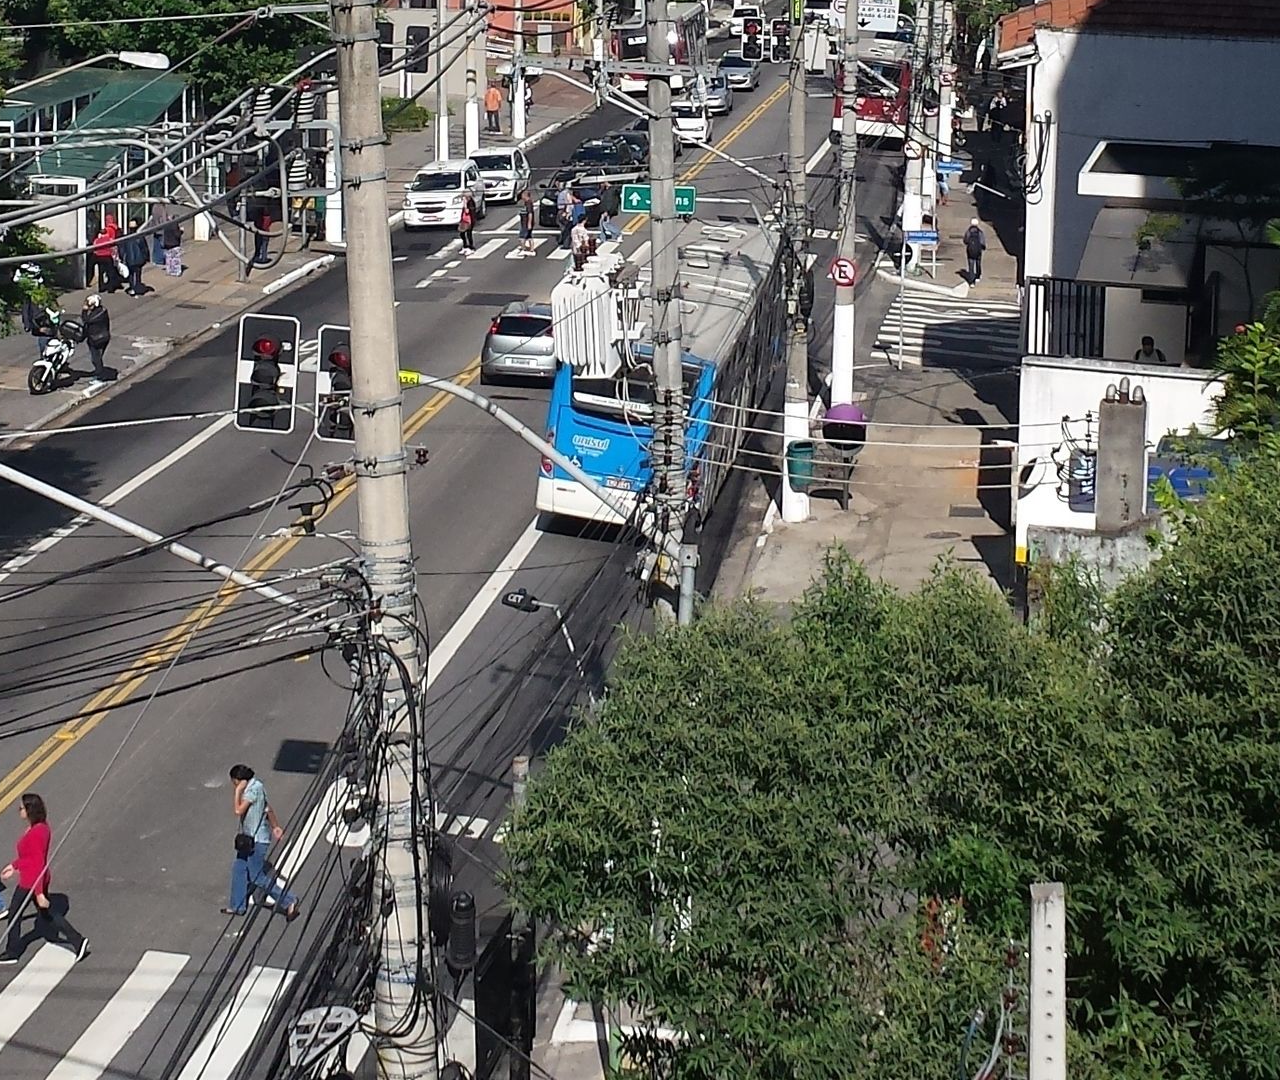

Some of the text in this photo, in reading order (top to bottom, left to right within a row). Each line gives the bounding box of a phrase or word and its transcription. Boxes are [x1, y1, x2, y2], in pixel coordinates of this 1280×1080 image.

[839, 264, 848, 279] E
[573, 434, 611, 450] unisul
[507, 593, 525, 604] CET
